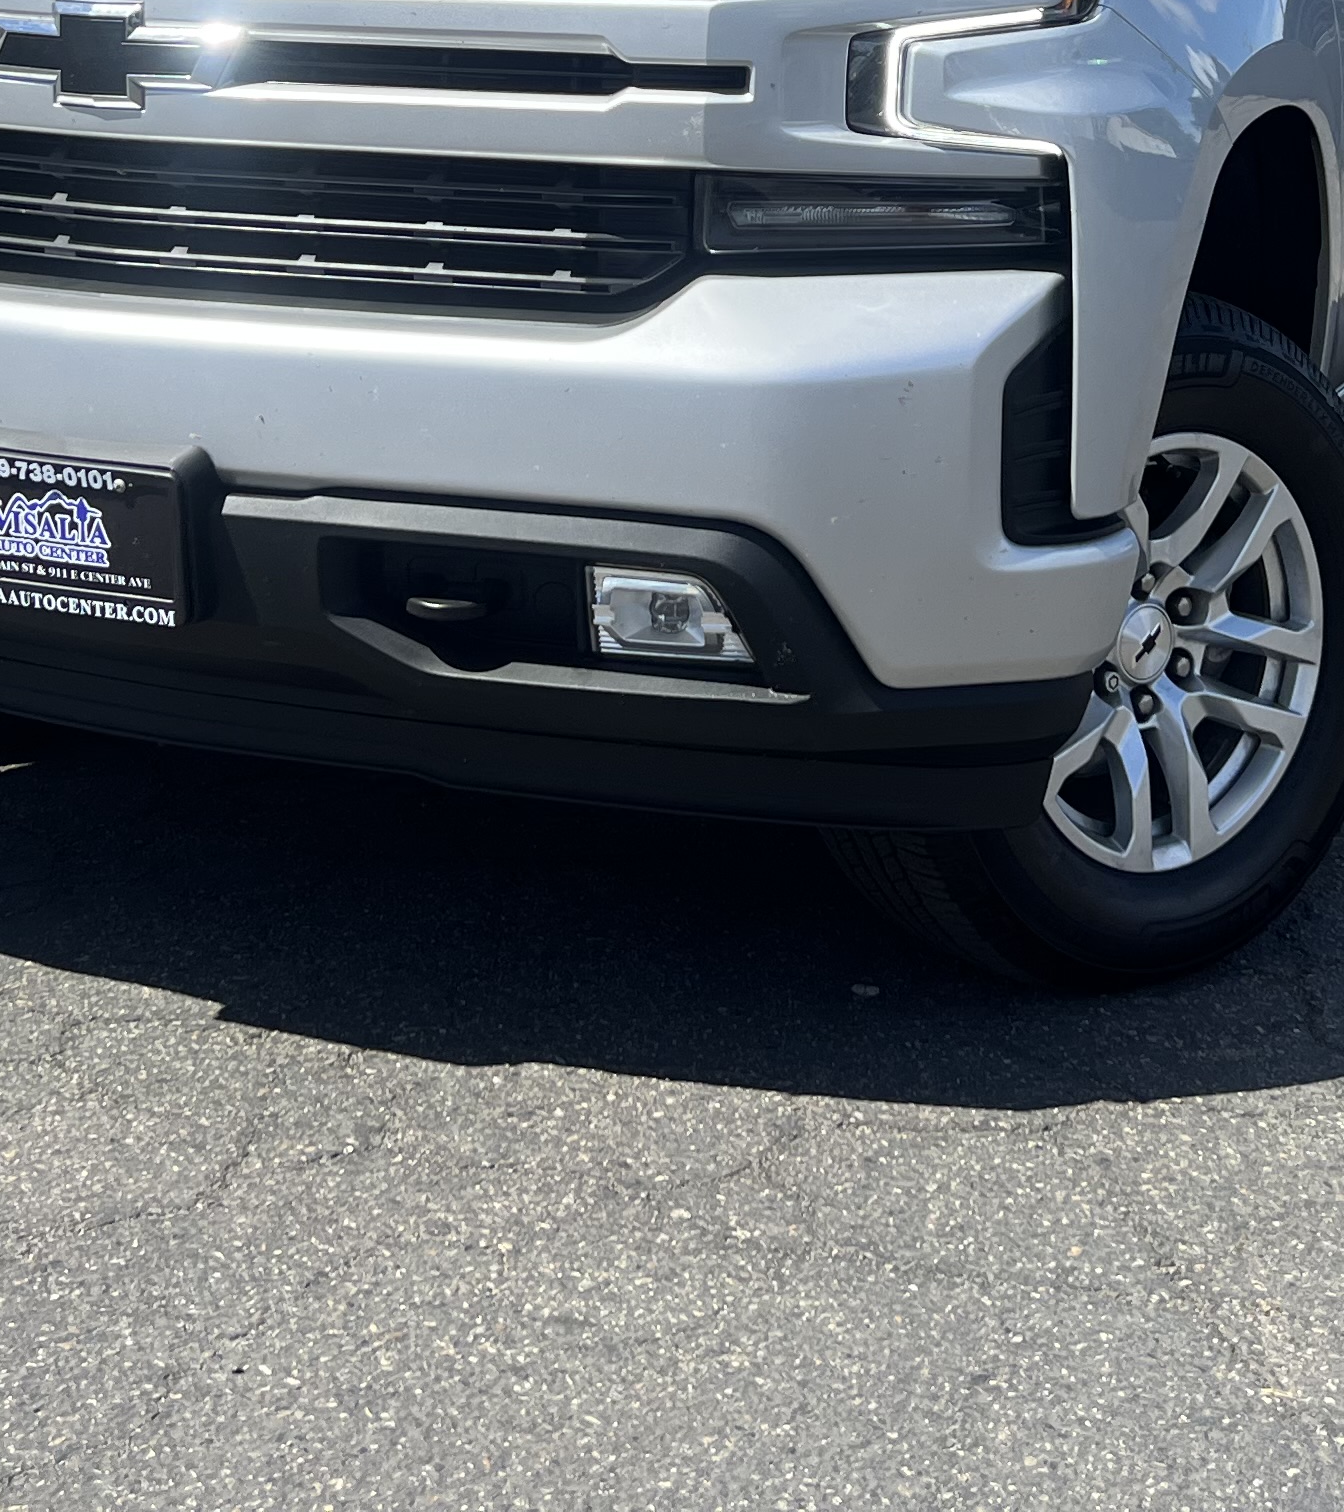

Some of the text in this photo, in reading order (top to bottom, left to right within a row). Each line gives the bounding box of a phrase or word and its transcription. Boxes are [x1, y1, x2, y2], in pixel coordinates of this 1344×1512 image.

[38, 542, 110, 567] CENTER
[21, 563, 36, 574] ST
[36, 565, 47, 576] &
[48, 566, 68, 579] 911
[70, 569, 80, 581] E
[80, 570, 126, 587] CENTER
[128, 577, 152, 590] AVE
